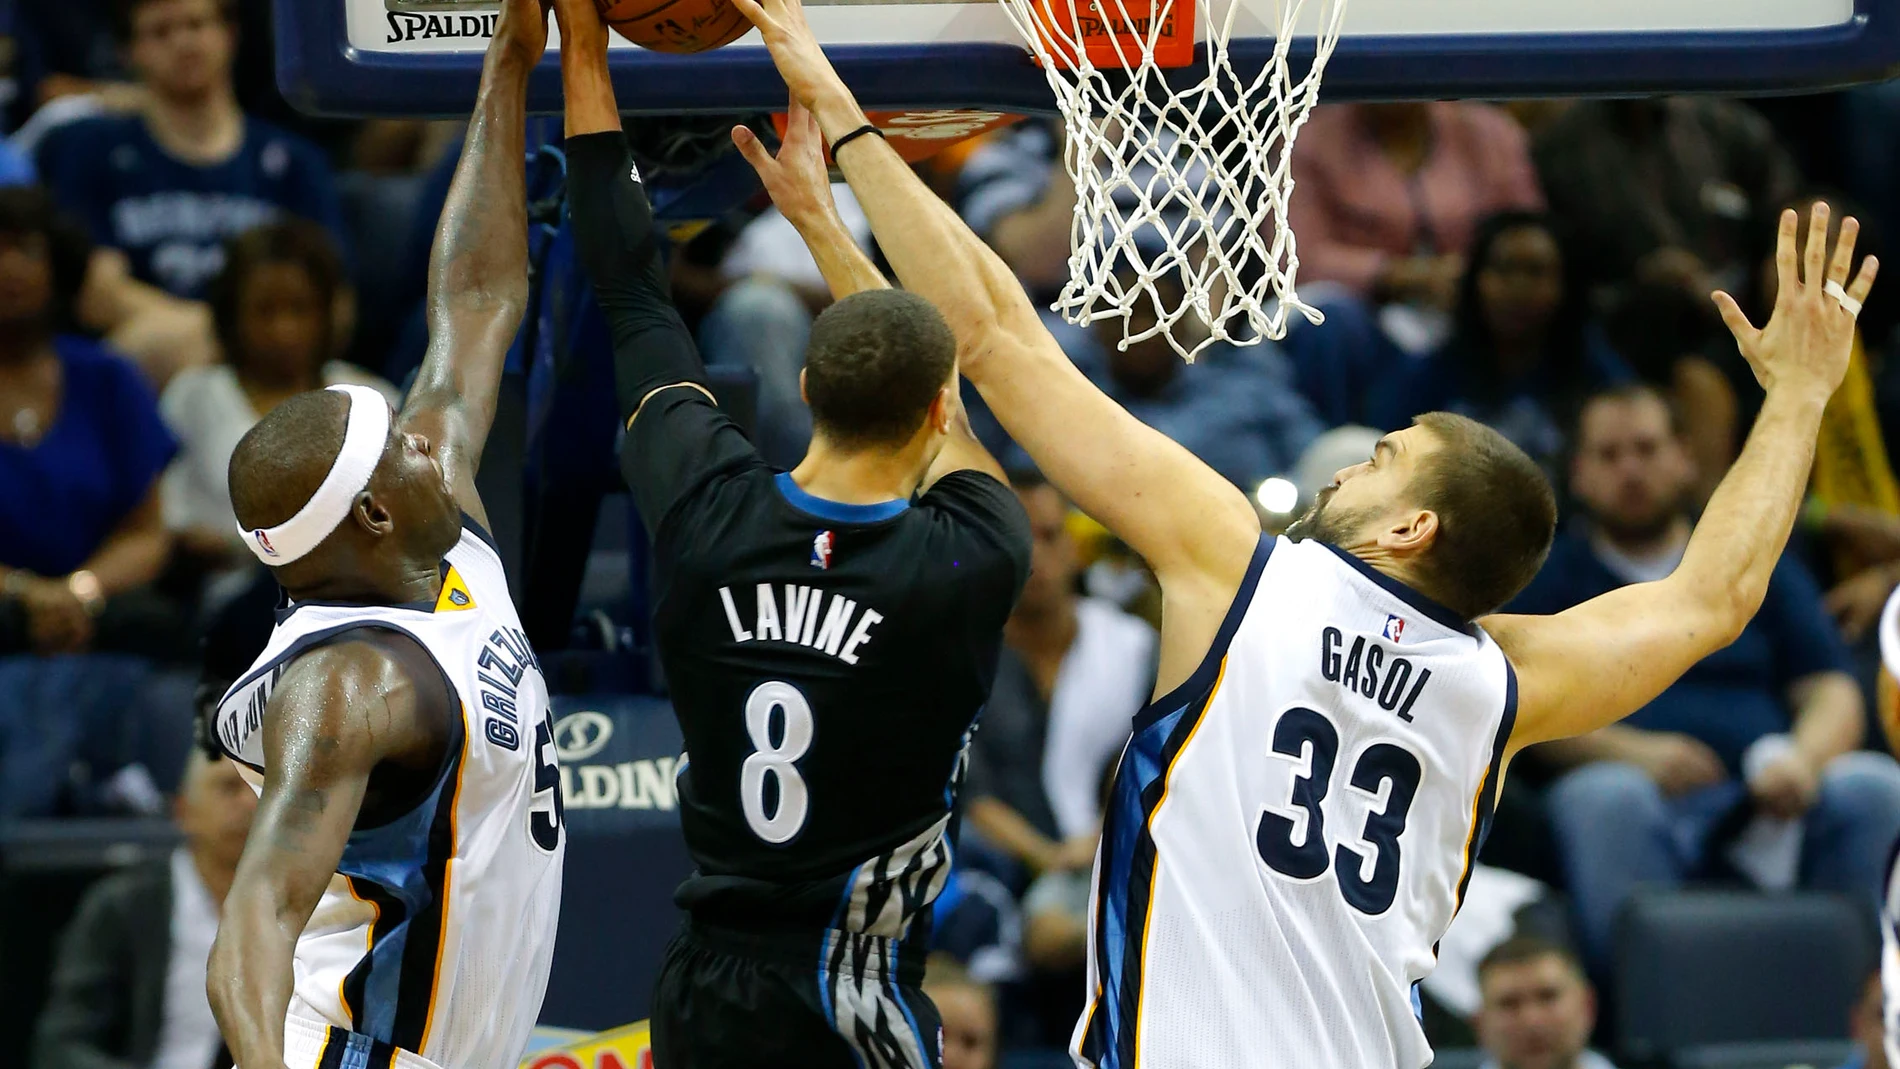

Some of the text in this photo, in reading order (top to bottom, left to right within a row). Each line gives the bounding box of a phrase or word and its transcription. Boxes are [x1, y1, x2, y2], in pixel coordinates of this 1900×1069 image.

[718, 582, 885, 665] LAVINE
[1321, 626, 1432, 723] GASOL
[530, 706, 566, 852] 5
[740, 680, 815, 845] 8
[1256, 706, 1422, 916] 33
